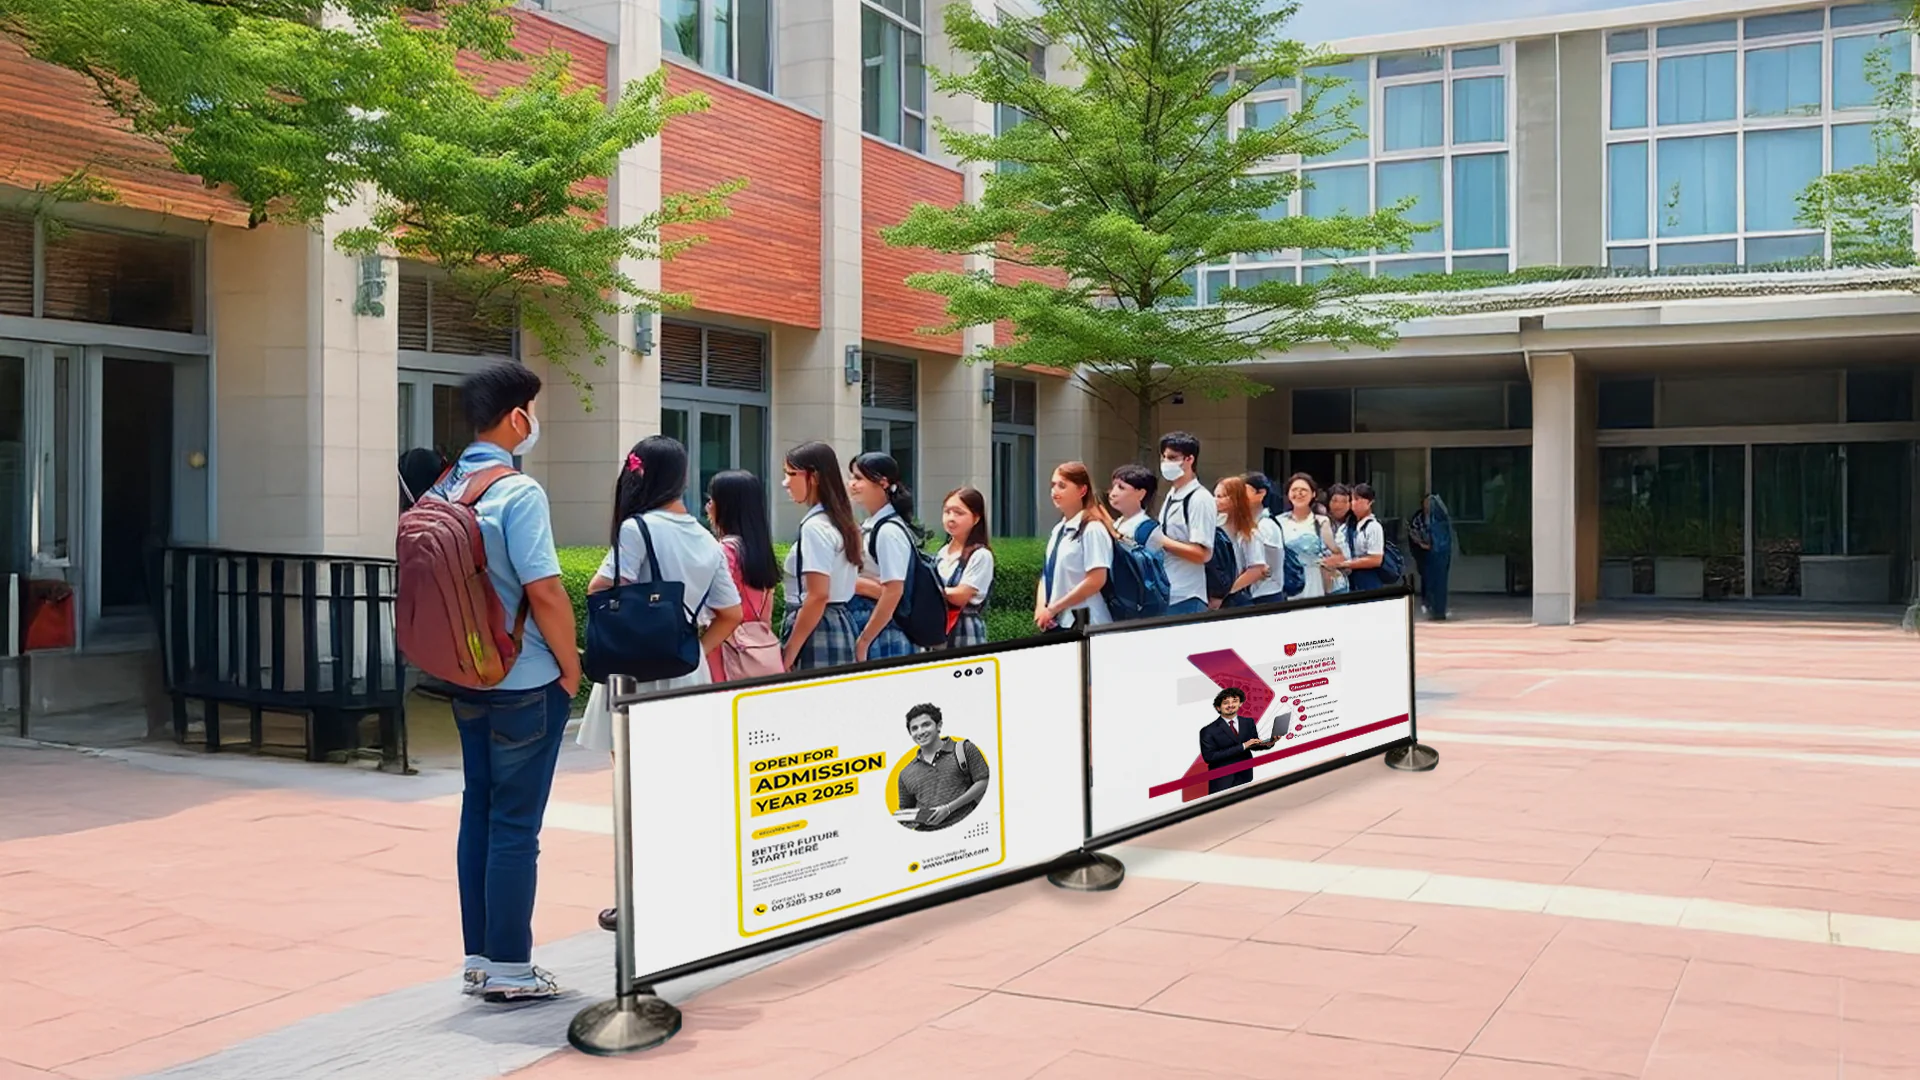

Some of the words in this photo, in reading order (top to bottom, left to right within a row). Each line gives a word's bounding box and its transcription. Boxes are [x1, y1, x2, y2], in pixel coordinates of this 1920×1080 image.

[1274, 669, 1288, 677] Job
[1288, 664, 1313, 673] Market
[754, 755, 799, 772] OPEN
[803, 748, 834, 762] FOR
[755, 755, 883, 793] ADMISSION
[756, 792, 807, 813] YEAR
[812, 781, 855, 801] 2025
[752, 840, 795, 858] BETTER
[797, 829, 840, 847] FUTURE
[752, 850, 787, 867] START
[789, 842, 819, 857] HERE
[771, 903, 784, 912] 00
[808, 892, 824, 902] 332
